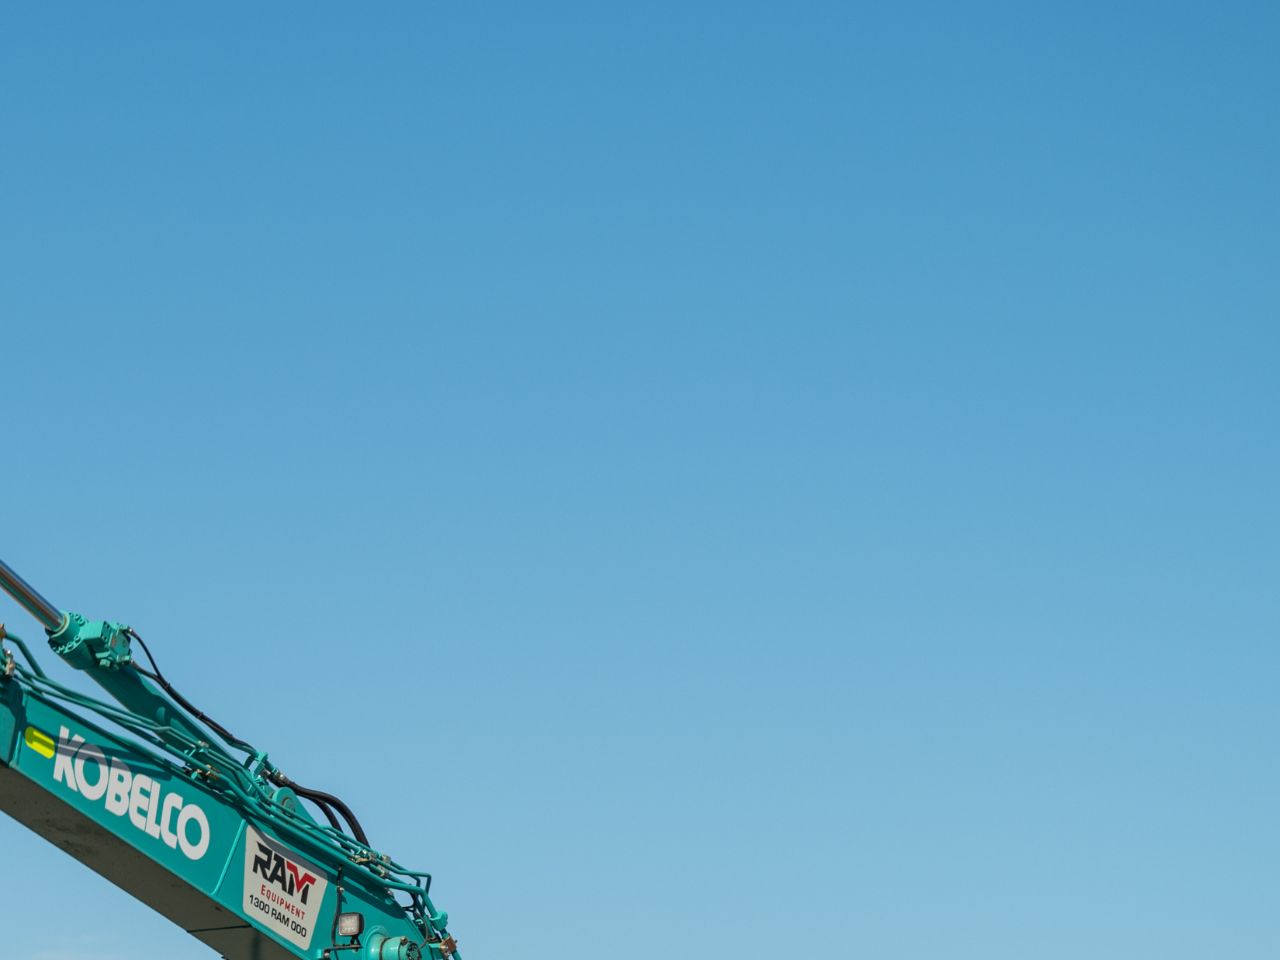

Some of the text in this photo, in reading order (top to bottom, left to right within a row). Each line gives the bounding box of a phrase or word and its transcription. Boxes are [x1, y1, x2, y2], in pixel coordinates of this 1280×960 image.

[53, 724, 210, 861] KOBELCO
[252, 841, 317, 905] RAM
[249, 894, 307, 938] 1300 RAM 000
[260, 883, 306, 921] EQUIPMENT
